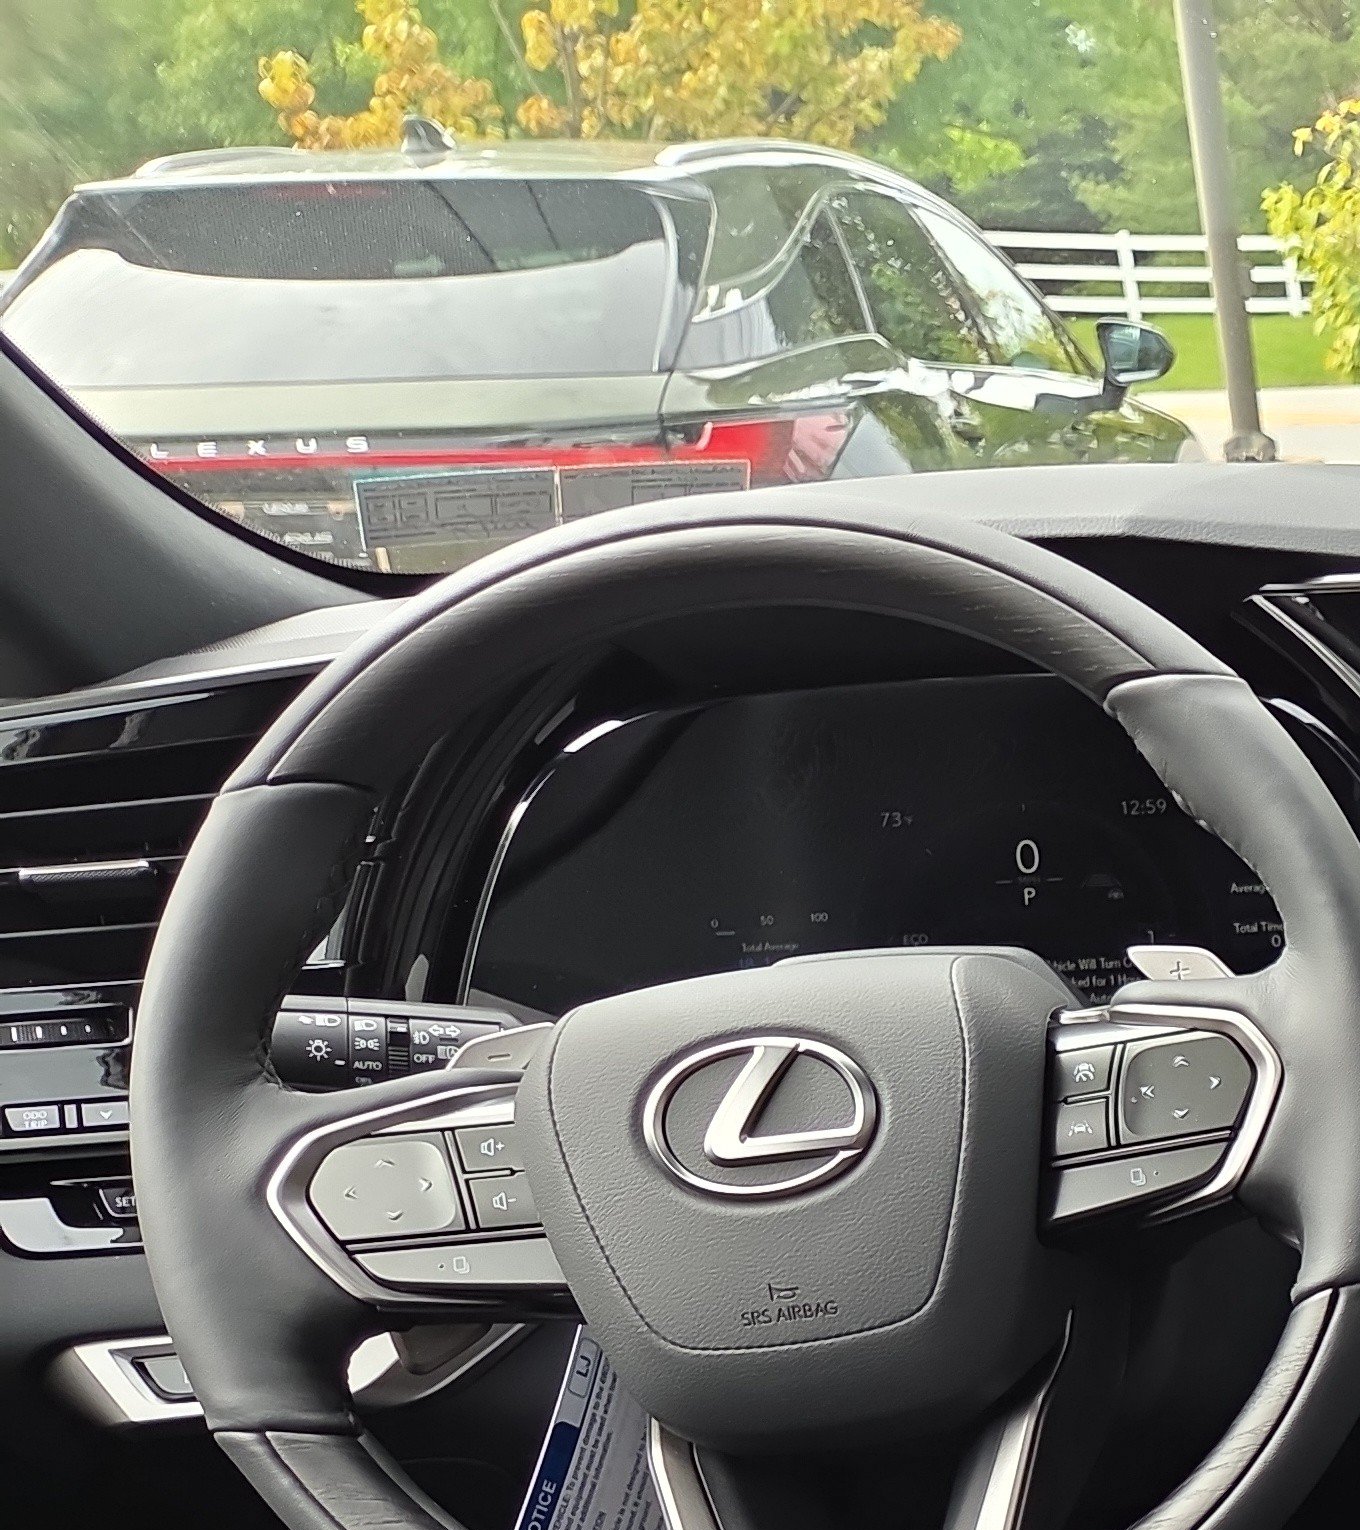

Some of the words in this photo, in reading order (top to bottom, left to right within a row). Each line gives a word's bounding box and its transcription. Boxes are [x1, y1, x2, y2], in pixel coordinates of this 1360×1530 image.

[150, 436, 369, 459] LEXUS
[1121, 799, 1168, 816] 12:59
[1015, 839, 1040, 874] 0
[1023, 887, 1036, 906] P
[760, 915, 774, 926] 50
[810, 912, 829, 923] 100
[1233, 922, 1258, 933] Total
[1271, 935, 1282, 947] 0
[1078, 958, 1097, 970] Will
[1099, 957, 1121, 969] Turn
[353, 1060, 382, 1071] AUTO
[413, 1053, 435, 1064] OFF
[23, 1119, 48, 1129] TRIP
[740, 1309, 771, 1328] SRS
[776, 1300, 839, 1324] AIRBAG
[575, 1356, 592, 1377] LJ
